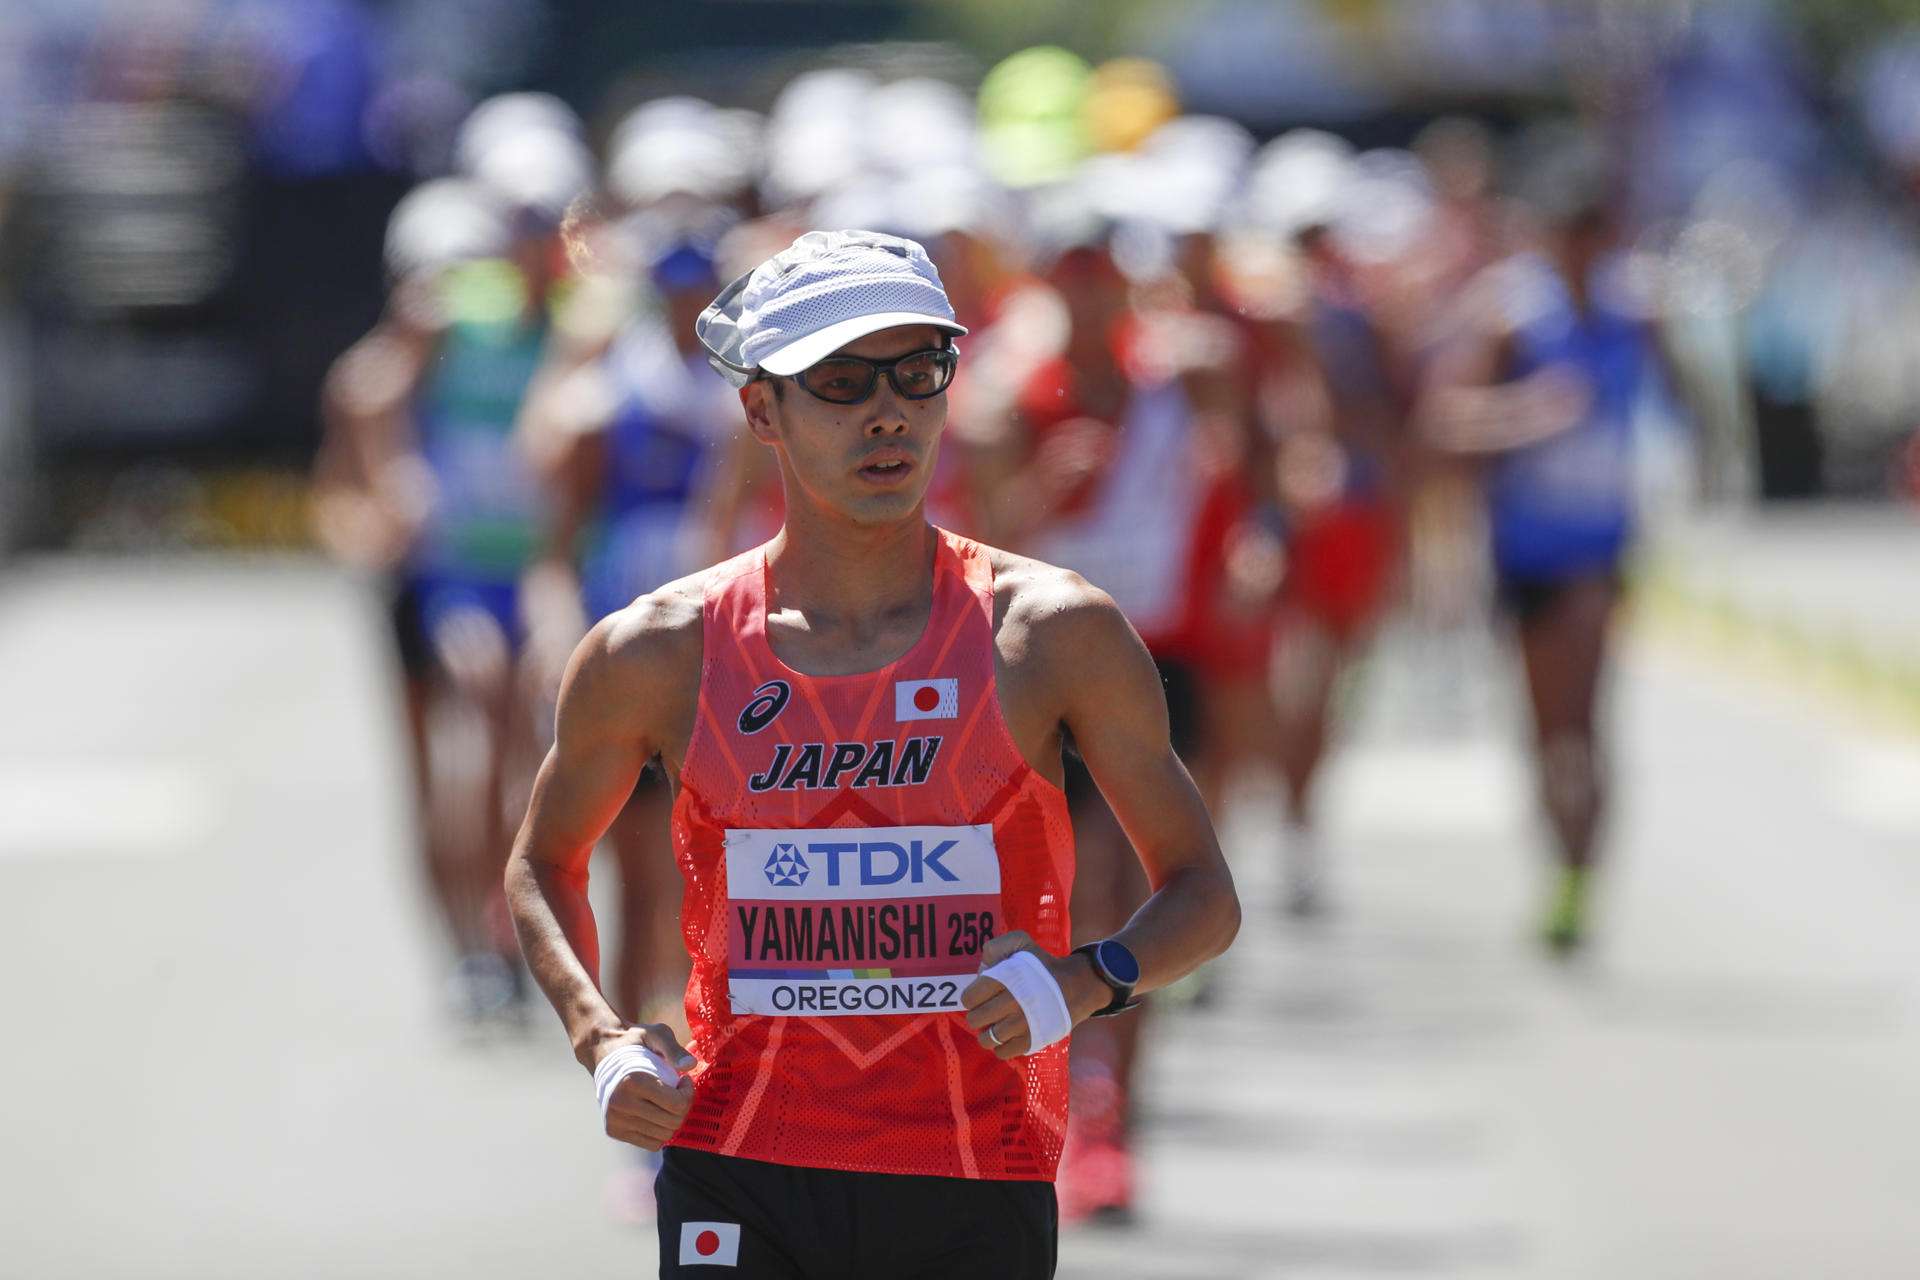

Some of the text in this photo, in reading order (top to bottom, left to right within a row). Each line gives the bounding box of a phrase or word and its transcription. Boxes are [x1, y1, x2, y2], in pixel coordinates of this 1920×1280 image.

[748, 736, 943, 792] JAPAN
[808, 840, 960, 886] TDK
[737, 903, 994, 961] YAMANISHI 258
[772, 982, 958, 1011] OREGON22
